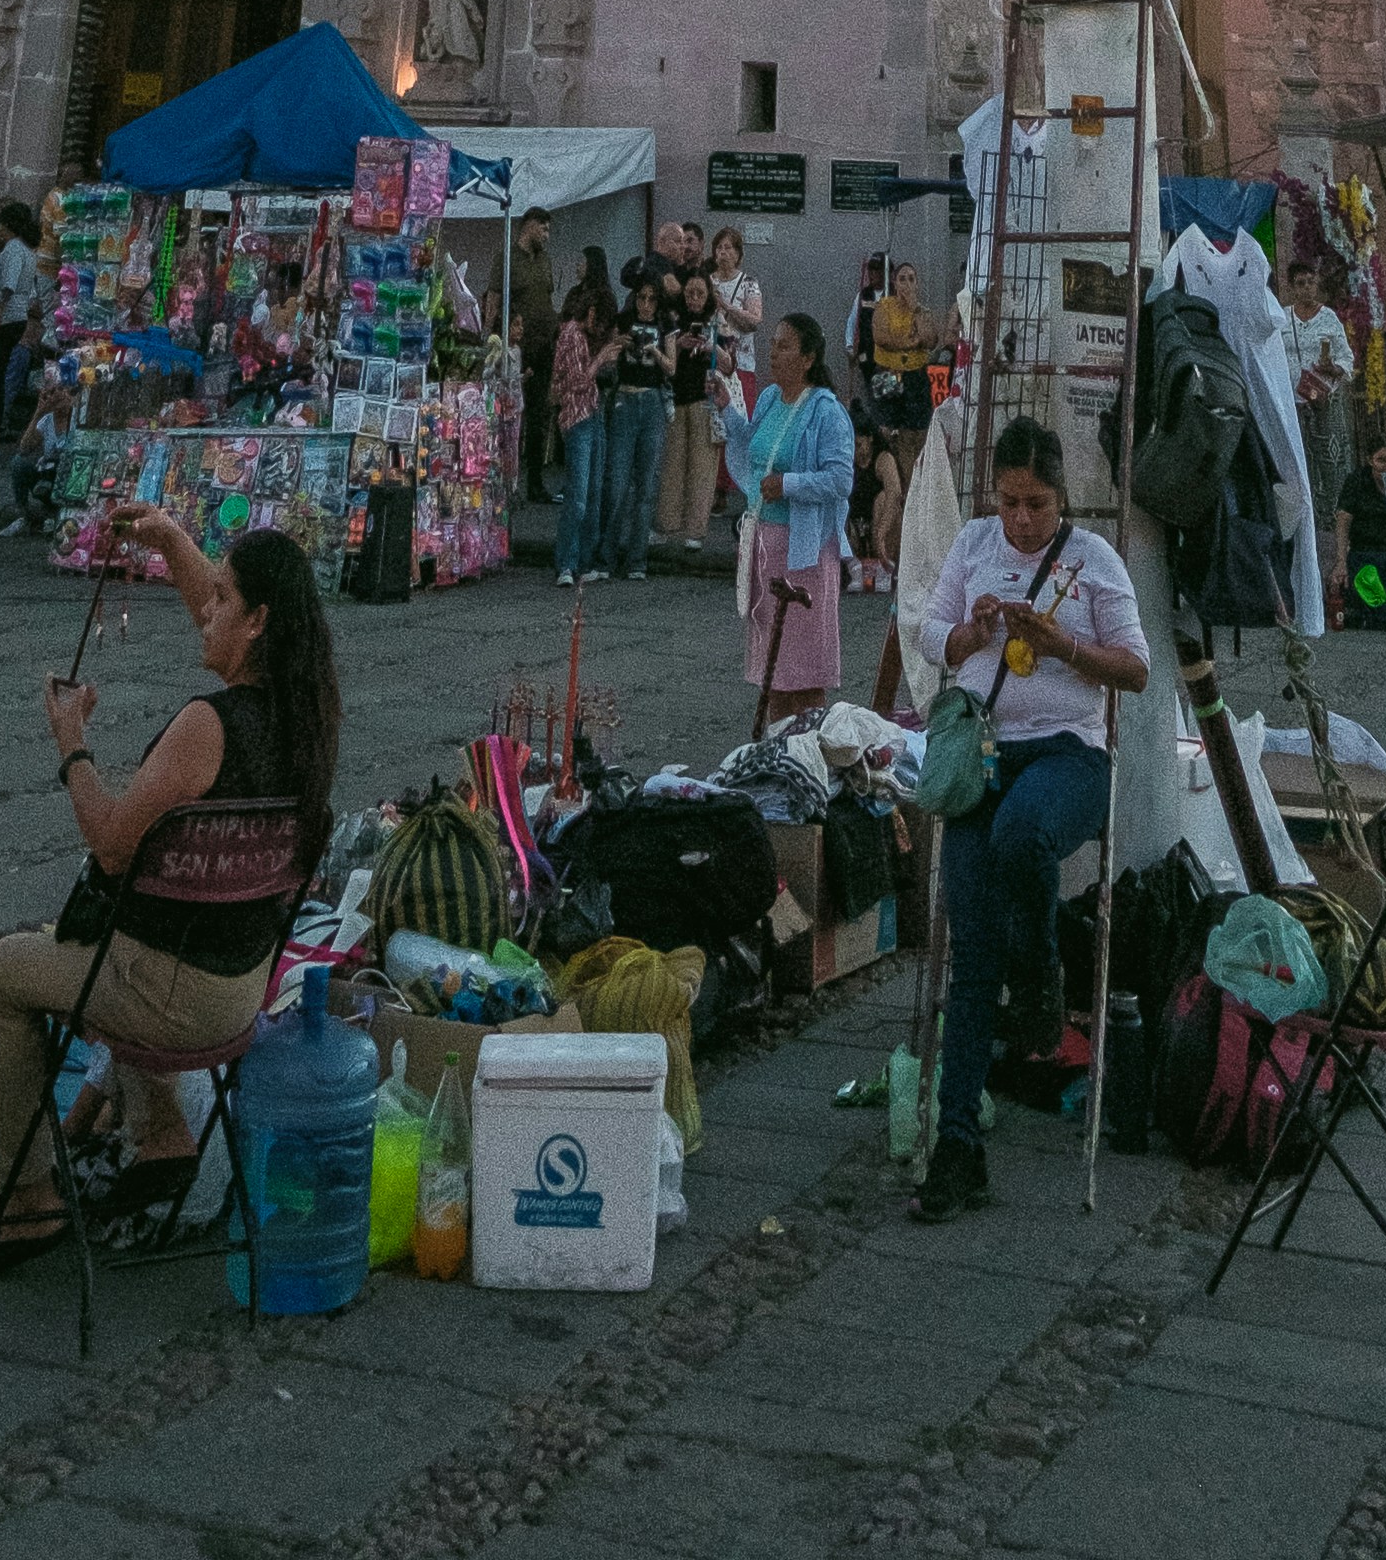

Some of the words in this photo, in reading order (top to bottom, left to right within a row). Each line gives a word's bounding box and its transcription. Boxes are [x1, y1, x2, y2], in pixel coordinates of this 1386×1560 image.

[1076, 324, 1126, 345] ¡ATENC
[183, 814, 266, 839] TEMPLO
[162, 850, 210, 879] SAN
